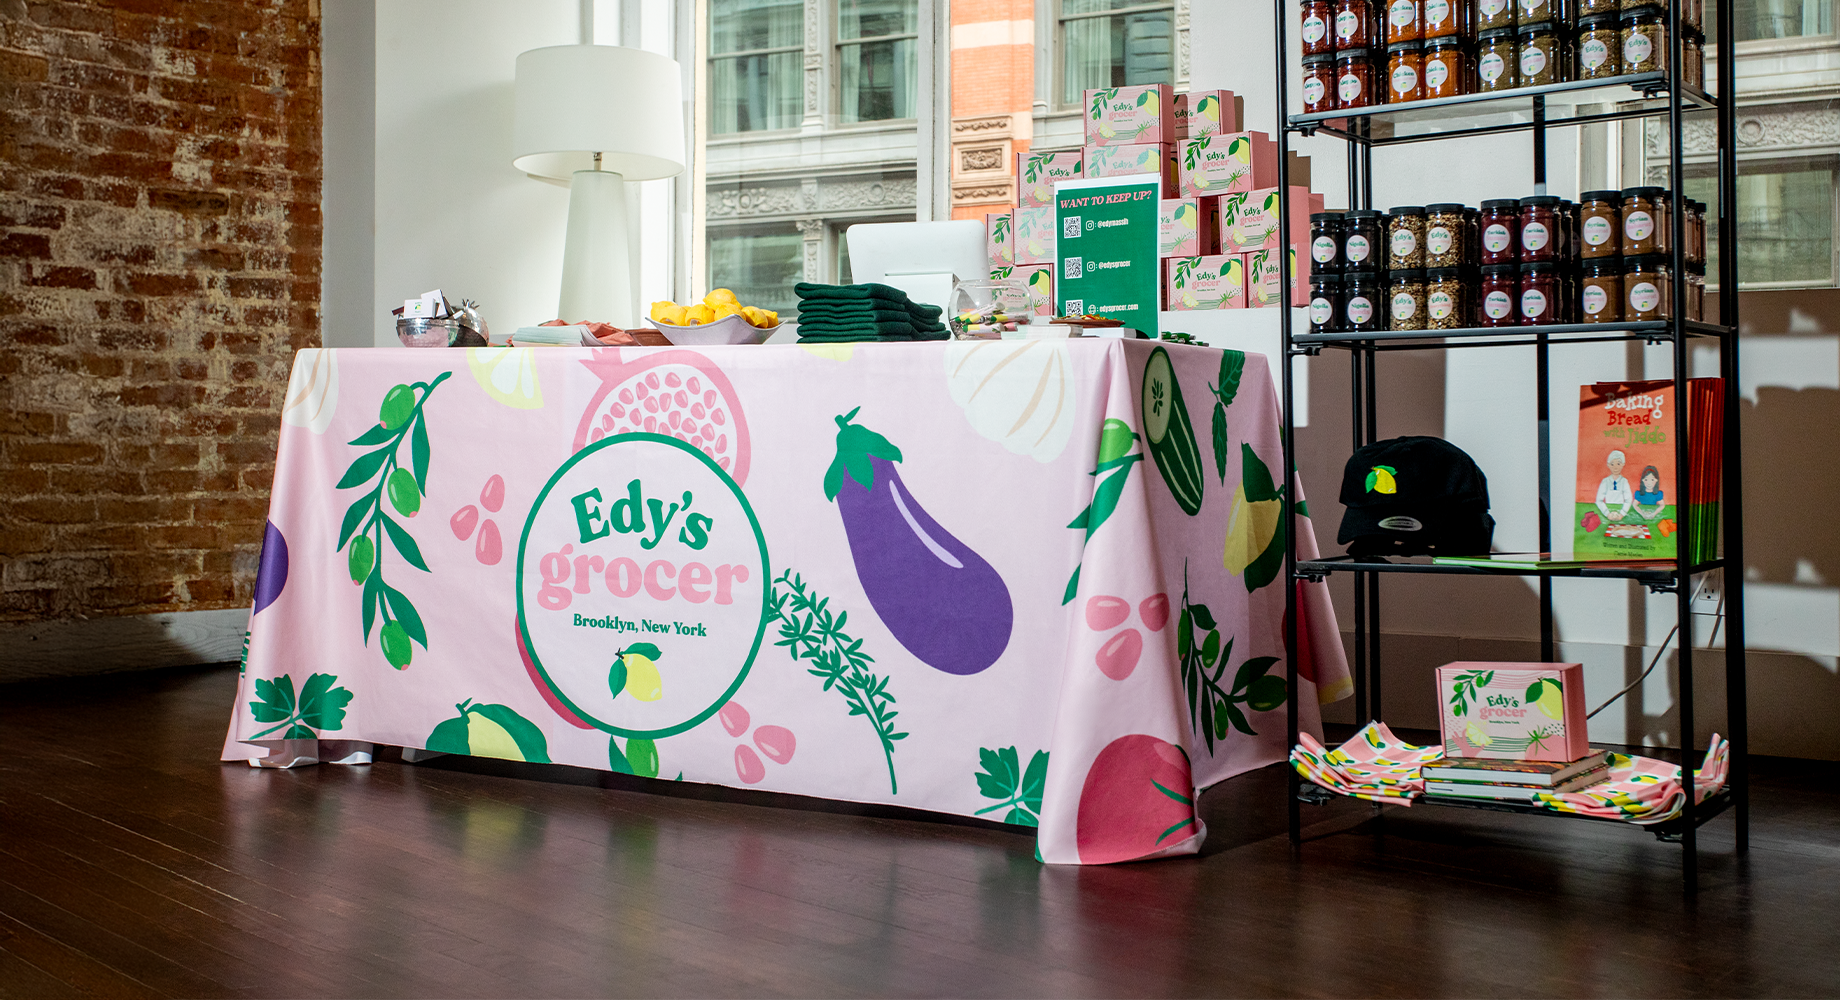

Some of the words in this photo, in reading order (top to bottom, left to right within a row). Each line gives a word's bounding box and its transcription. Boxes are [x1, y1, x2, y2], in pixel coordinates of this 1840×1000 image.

[1113, 102, 1133, 112] Edy's
[1108, 110, 1138, 121] grocer
[1174, 108, 1194, 119] Edy's
[1206, 151, 1225, 161] Edy's
[1112, 160, 1133, 170] Edy's
[1202, 159, 1230, 171] grocer
[1049, 168, 1071, 177] Edy's
[1060, 197, 1089, 209] WANT
[1091, 195, 1105, 206] TO
[1105, 192, 1132, 204] KEEP
[1133, 190, 1152, 201] UP?
[1243, 207, 1261, 217] Edy's
[1240, 214, 1265, 226] grocer
[1266, 264, 1279, 274] Edy's
[1196, 271, 1216, 281] Edy's
[1192, 279, 1221, 290] grocer
[1604, 391, 1664, 419] Baking
[1607, 409, 1653, 426] Bread
[1603, 426, 1625, 438] with
[1624, 426, 1666, 448] Jiddo
[571, 479, 713, 550] Edy's
[537, 543, 749, 611] grocer
[573, 613, 638, 634] Brooklyn,
[641, 619, 671, 634] New
[673, 621, 707, 637] York
[1486, 694, 1519, 708] Edy's
[1479, 706, 1527, 720] grocer
